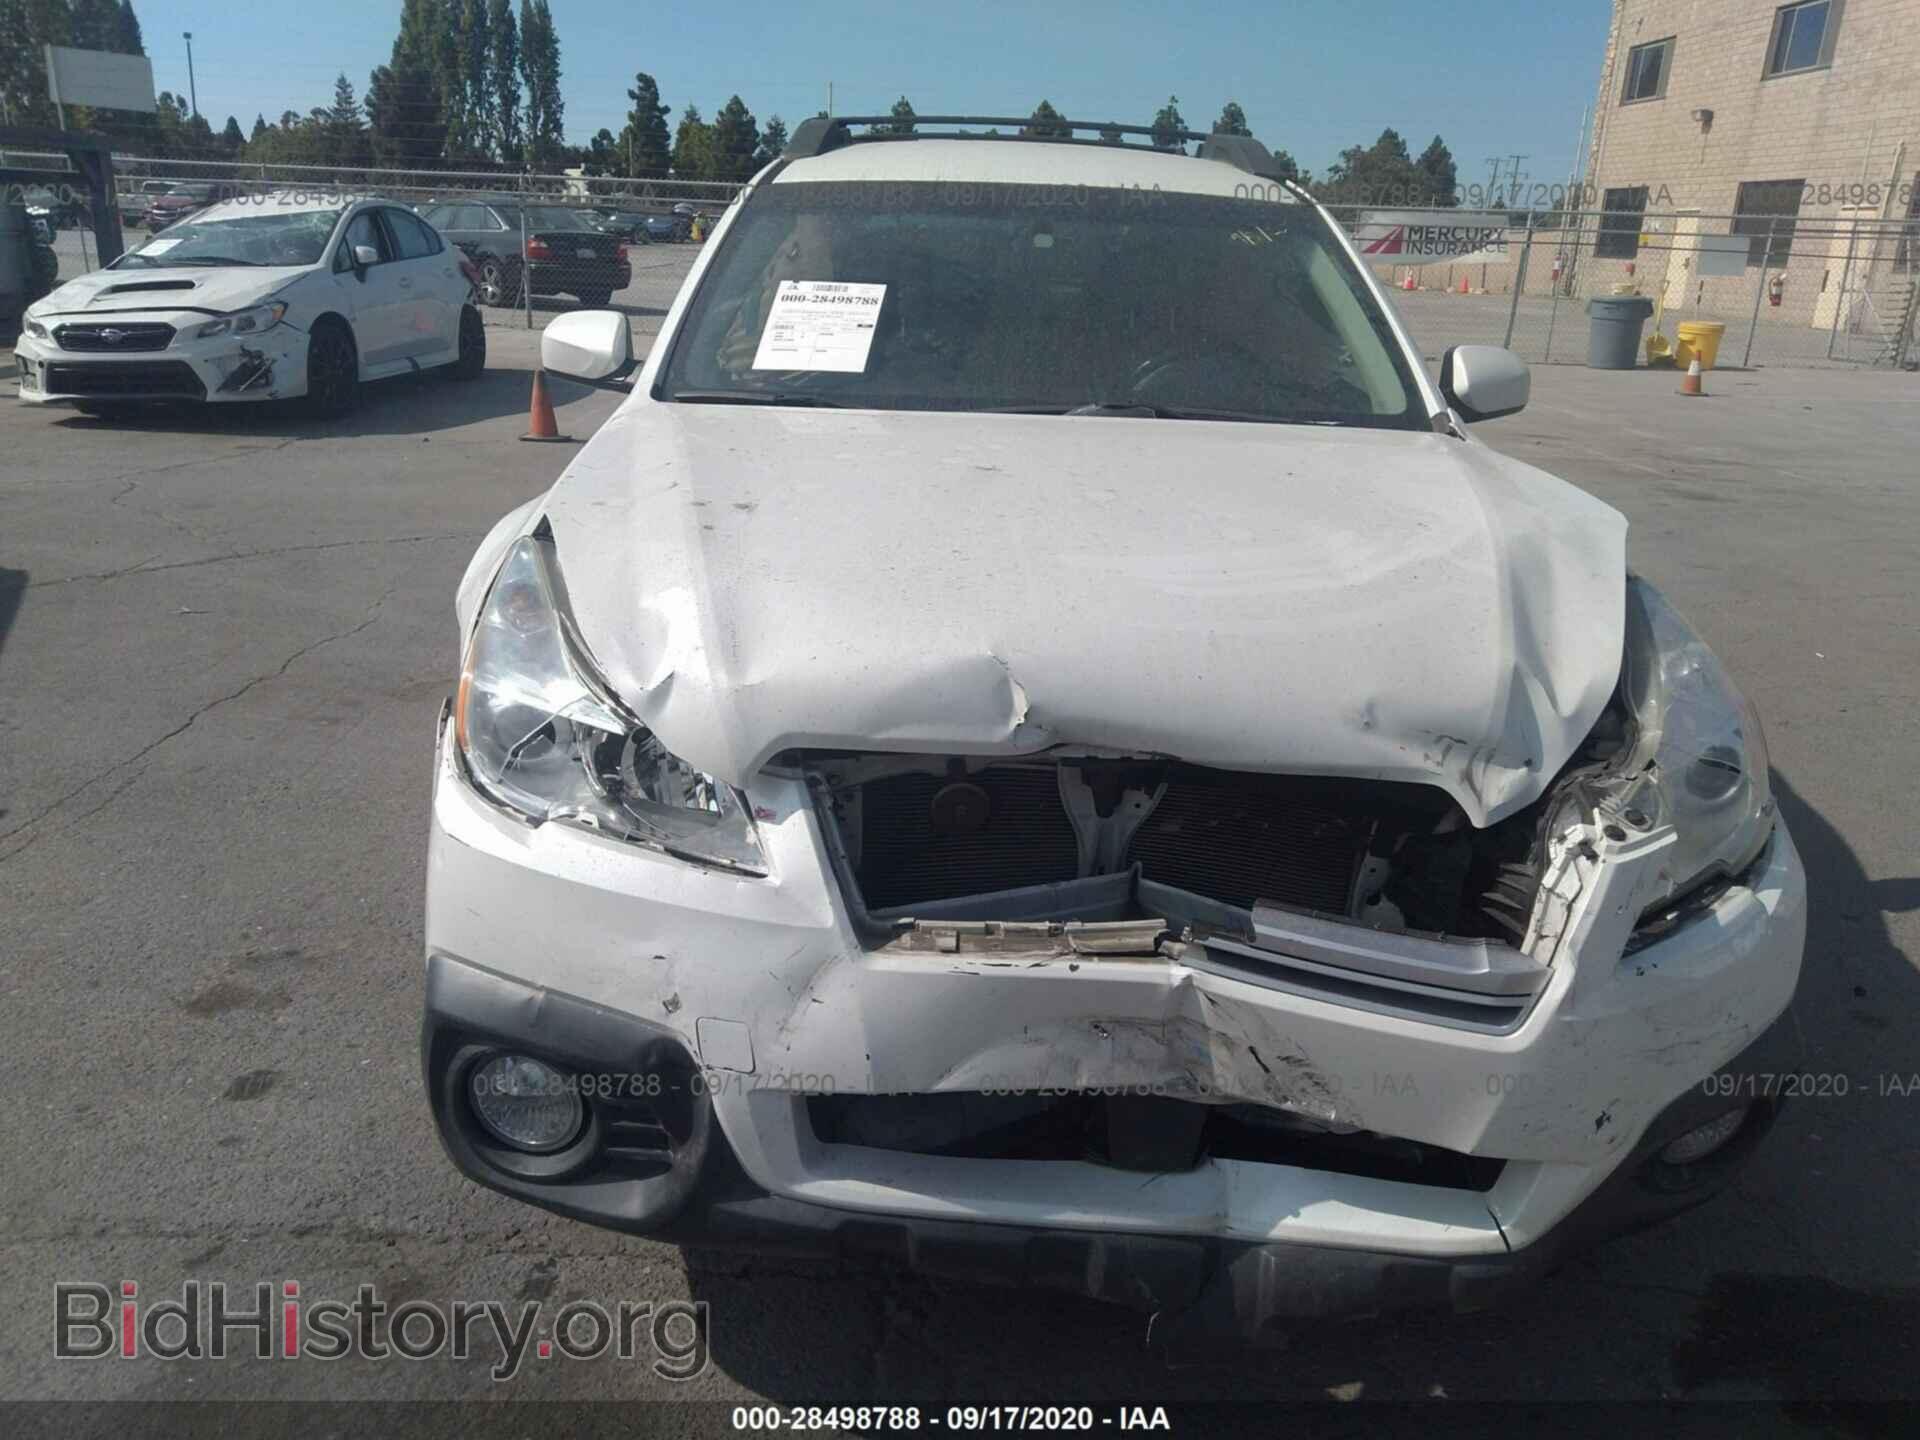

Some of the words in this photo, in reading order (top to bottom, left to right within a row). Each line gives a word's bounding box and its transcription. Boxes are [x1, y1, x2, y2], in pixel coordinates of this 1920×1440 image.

[1407, 225, 1505, 241] MERCURY
[1406, 241, 1508, 256] INSURANCE
[780, 293, 879, 305] 000-28498788
